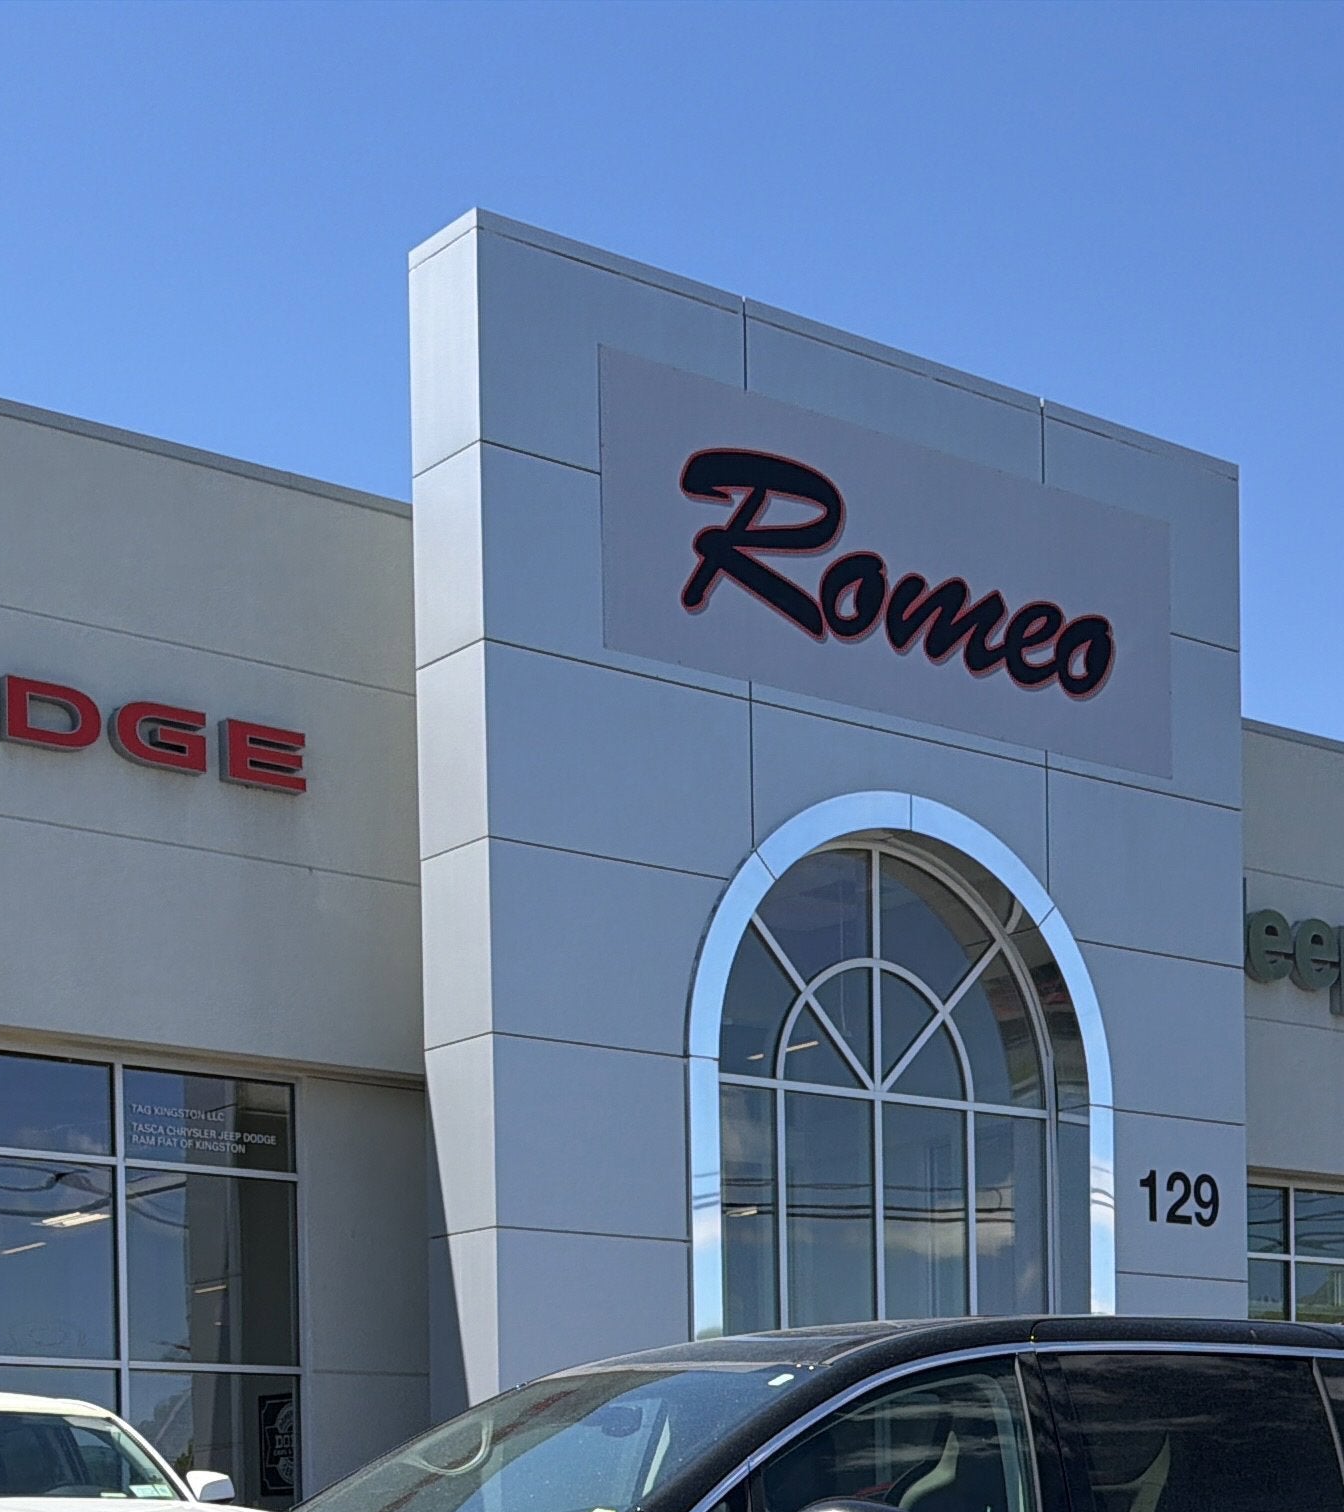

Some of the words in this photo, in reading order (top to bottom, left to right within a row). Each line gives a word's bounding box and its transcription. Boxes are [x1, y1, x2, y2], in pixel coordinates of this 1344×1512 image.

[679, 447, 1115, 700] Romeo
[131, 1103, 151, 1115] TAG
[154, 1107, 206, 1120] KINGSTON
[207, 1111, 225, 1122] LLC
[131, 1122, 165, 1135] TASCA
[166, 1125, 217, 1139] CHRYSLER
[218, 1131, 242, 1142] JEEP
[243, 1133, 277, 1146] DODGE
[131, 1134, 156, 1146] RAM
[157, 1137, 178, 1148] FIAT
[179, 1138, 194, 1148] OF
[195, 1140, 246, 1154] KINGSTON
[1139, 1169, 1220, 1228] 129
